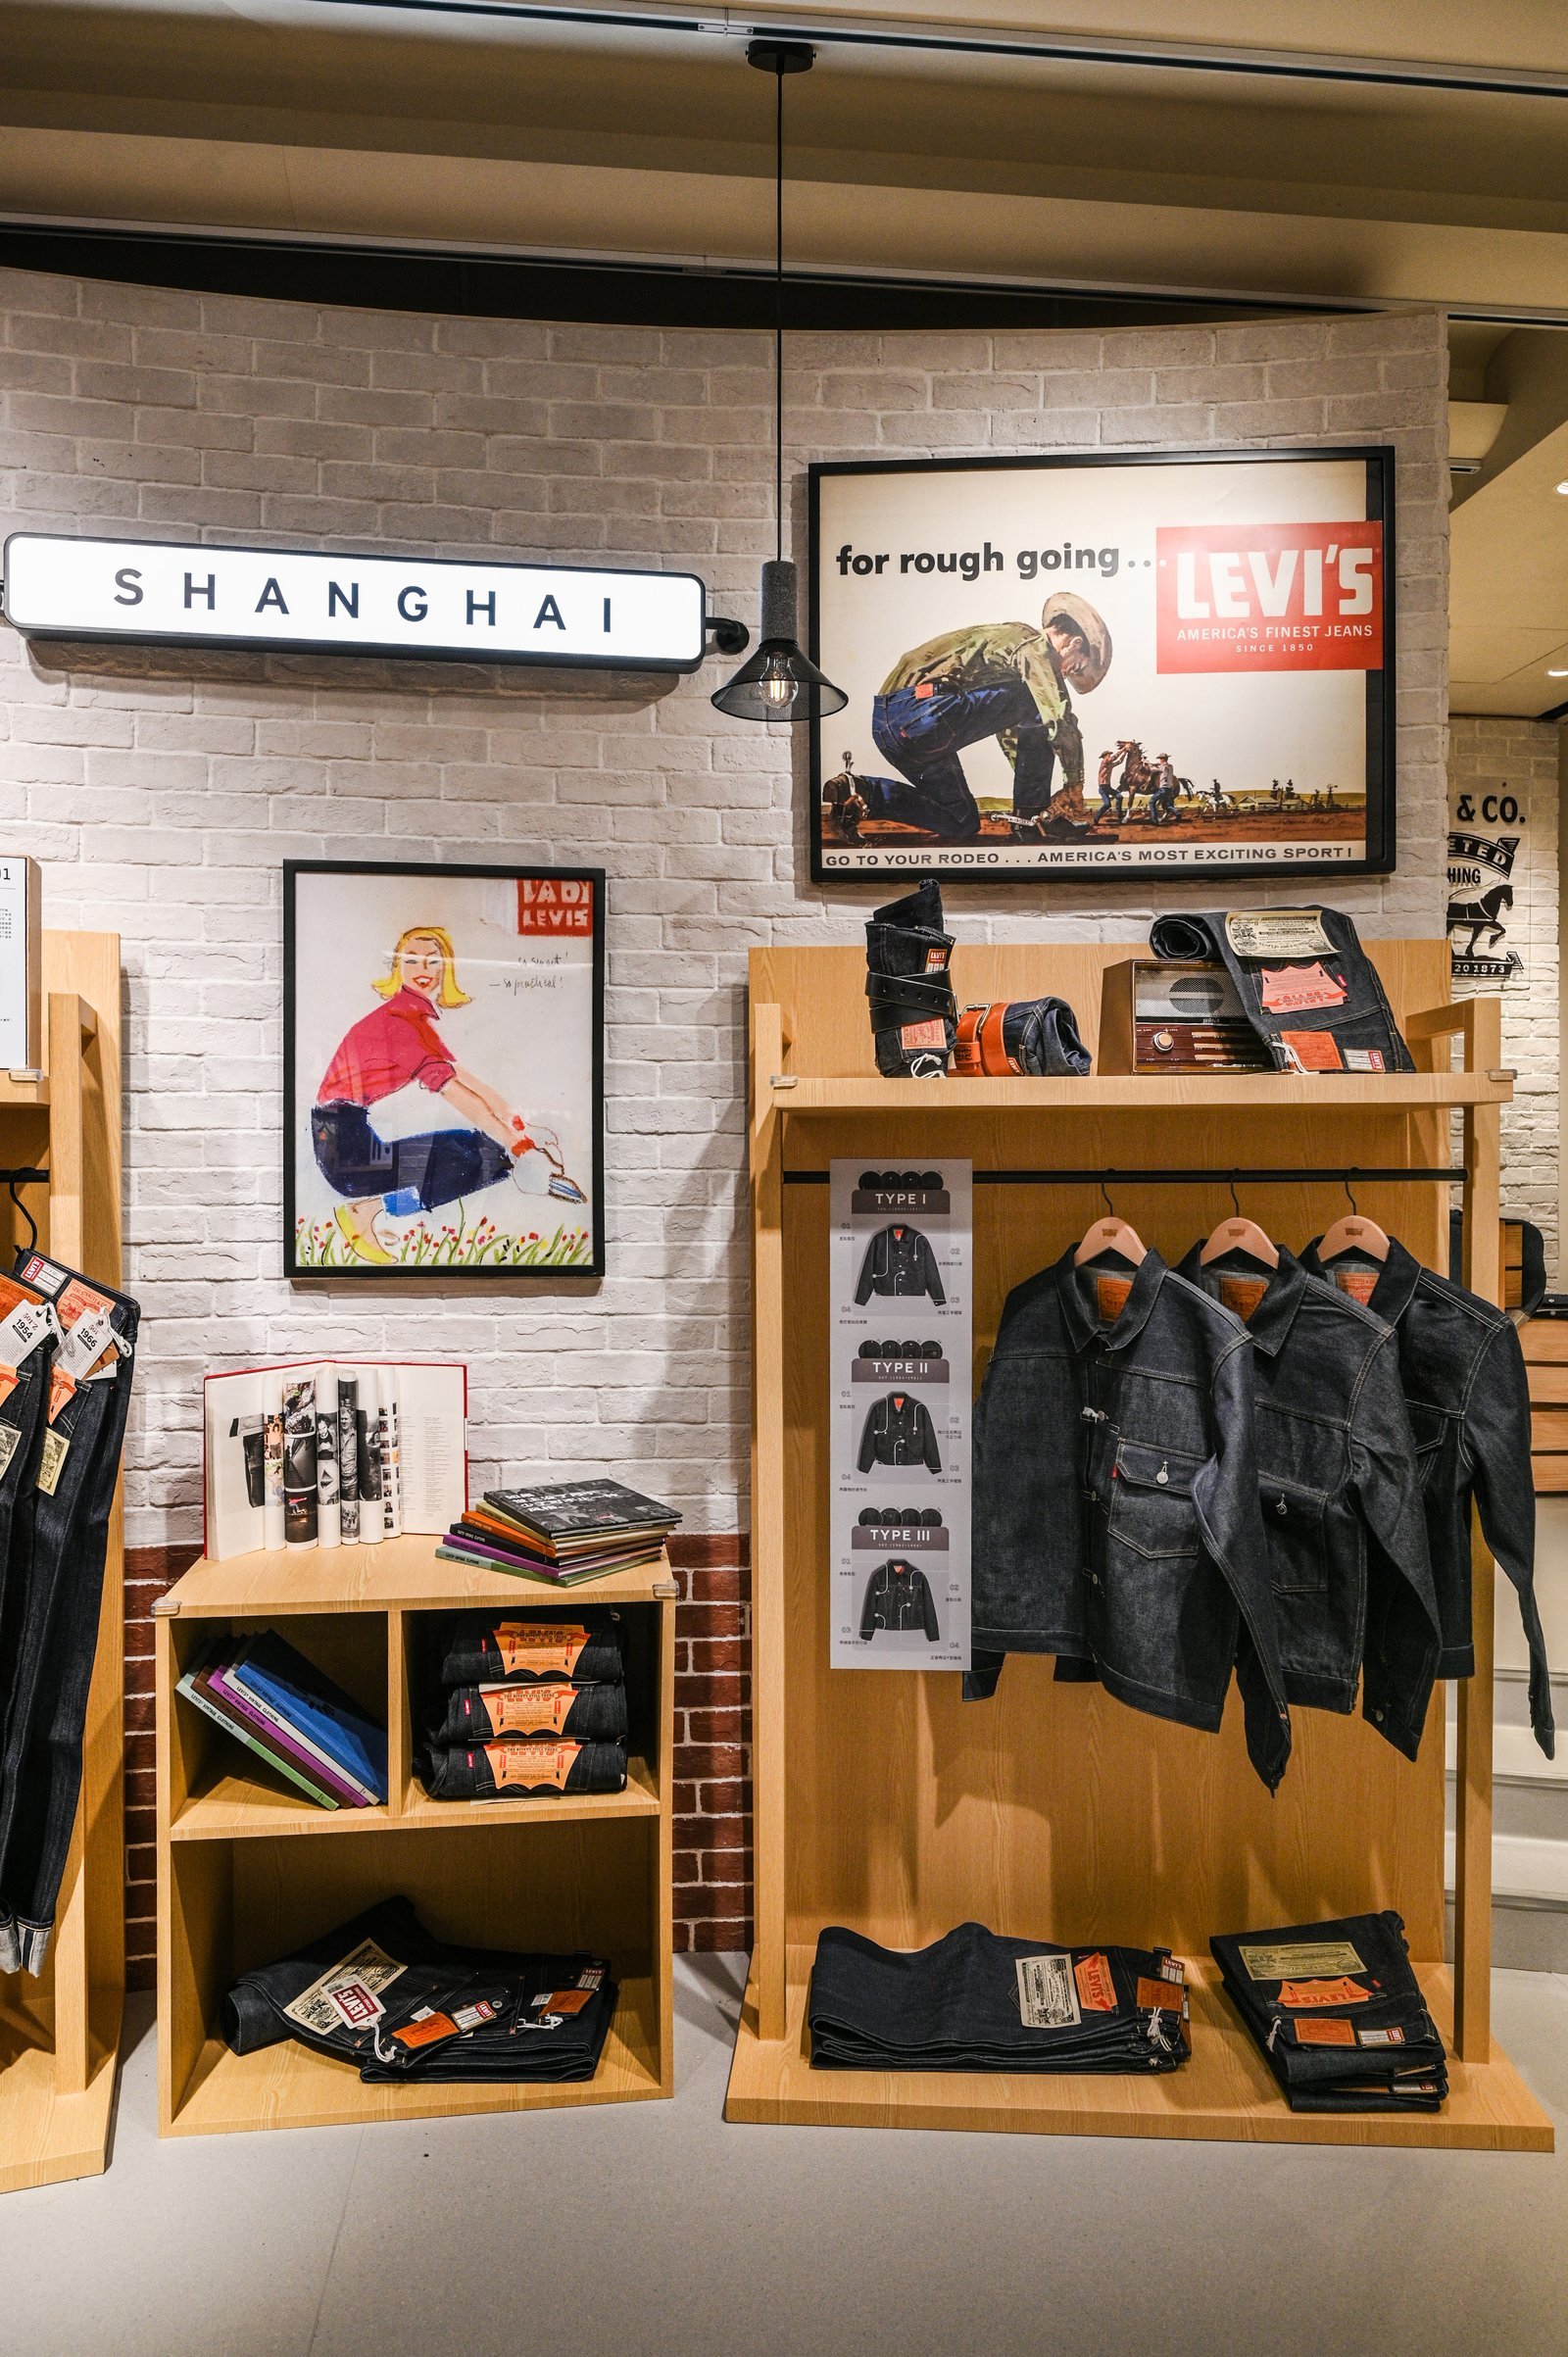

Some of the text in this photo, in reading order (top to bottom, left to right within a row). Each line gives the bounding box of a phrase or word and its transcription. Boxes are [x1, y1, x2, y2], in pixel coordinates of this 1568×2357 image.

[836, 545, 890, 575] for
[900, 542, 1004, 581] rough
[1177, 544, 1373, 619] LEVI'S
[114, 567, 612, 634] SHANGHAI
[1177, 624, 1373, 641] AMERICA'S FINEST JEANS
[1282, 644, 1313, 653] 1850
[1457, 795, 1526, 823] & CO.
[825, 856, 851, 866] GO
[857, 855, 879, 865] TO
[884, 854, 933, 865] YOUR
[938, 853, 1000, 864] RODEO
[1037, 851, 1132, 862] AMERICA'S
[1138, 850, 1189, 860] MOST
[1195, 849, 1277, 859] EXCITING
[522, 908, 589, 927] LEVIS
[1473, 963, 1505, 973] 1873
[875, 1194, 916, 1204] TYPE
[16, 1319, 33, 1339] 1954
[80, 1328, 98, 1348] 1966
[873, 1362, 913, 1373] TYPE
[870, 1530, 911, 1541] TYPE
[337, 1989, 369, 2020] LEVI'S
